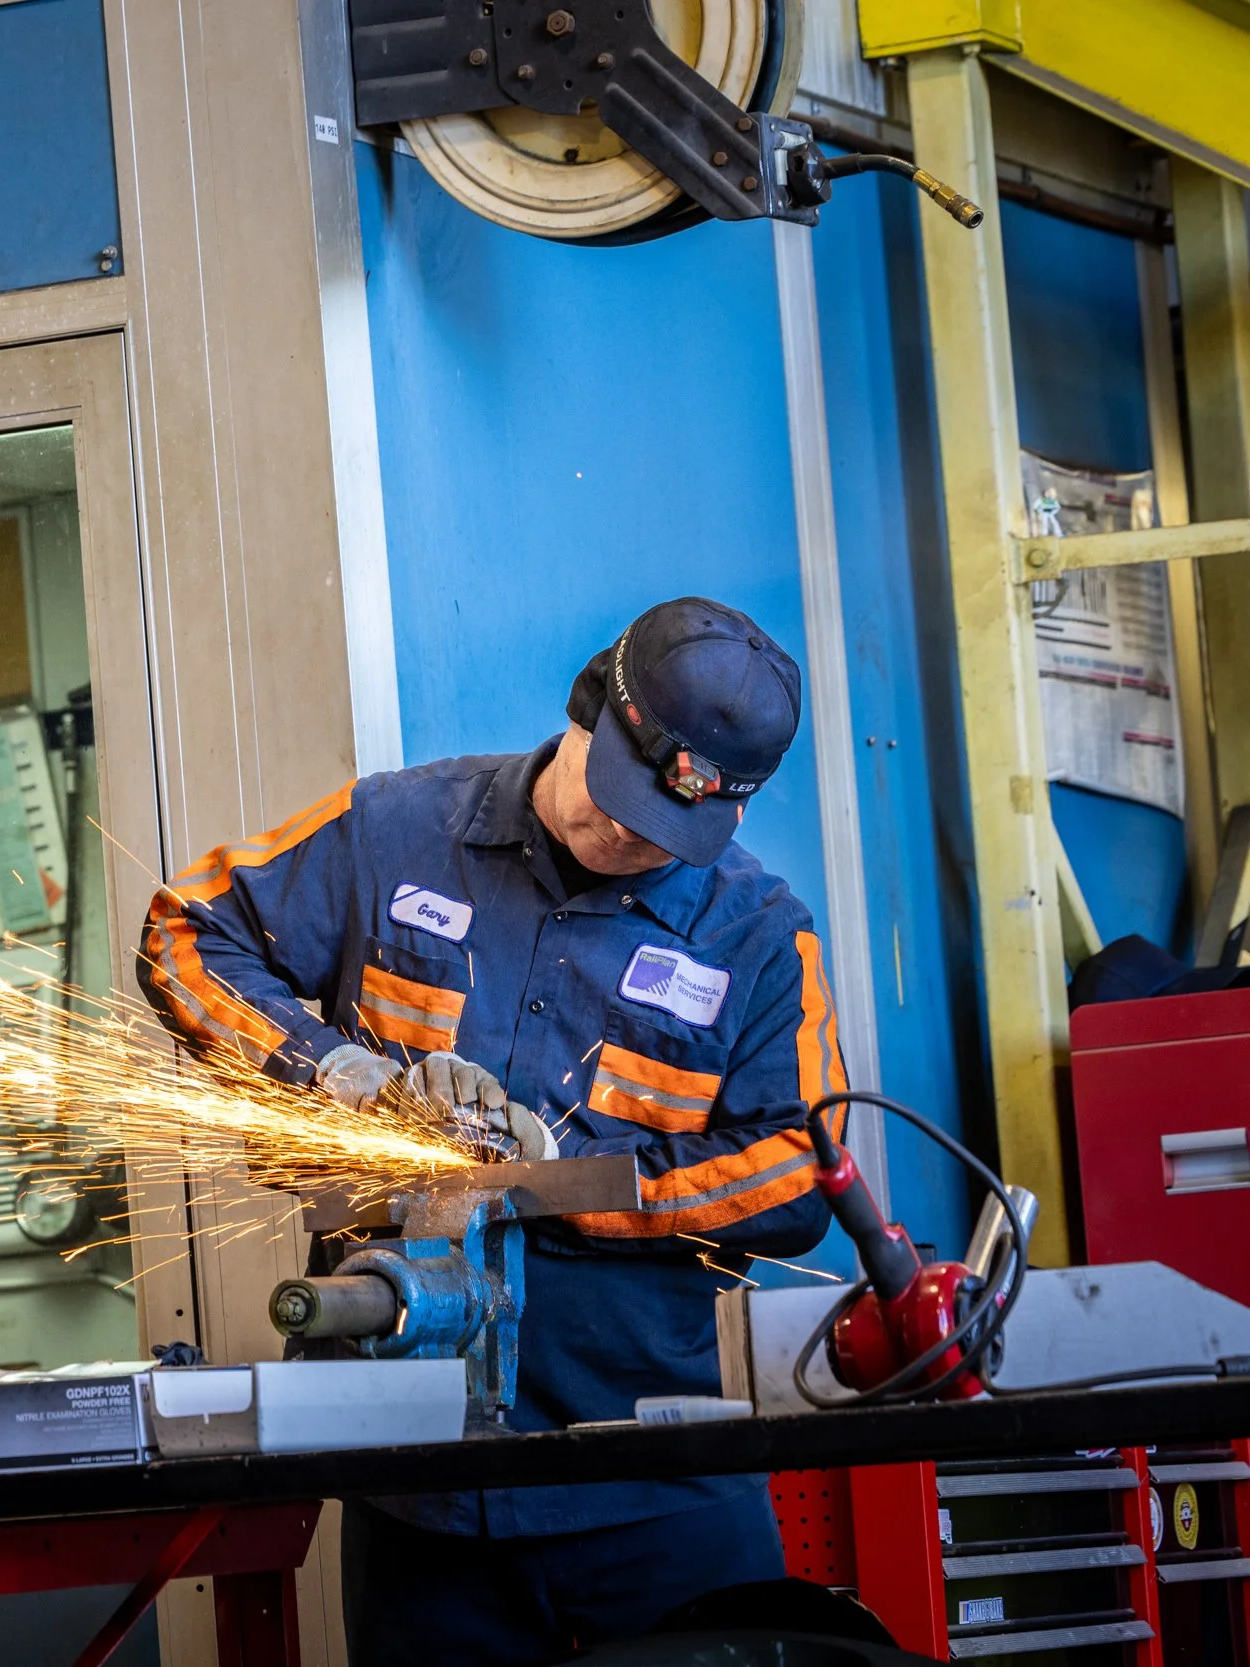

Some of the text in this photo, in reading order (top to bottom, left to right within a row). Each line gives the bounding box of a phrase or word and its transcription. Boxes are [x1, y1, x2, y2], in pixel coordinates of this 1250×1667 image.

[328, 125, 337, 137] PSI
[729, 783, 756, 792] LED
[417, 902, 450, 927] Gary
[639, 953, 677, 969] RailPlan
[676, 972, 722, 997] MECHANICAL
[677, 984, 713, 1005] SERVICES
[65, 1384, 131, 1400] GDNPF102X
[71, 1396, 131, 1409] POWDER FREE
[15, 1412, 45, 1422] NITRILE
[46, 1408, 98, 1421] EXAMINATION
[99, 1406, 132, 1417] GLOVES
